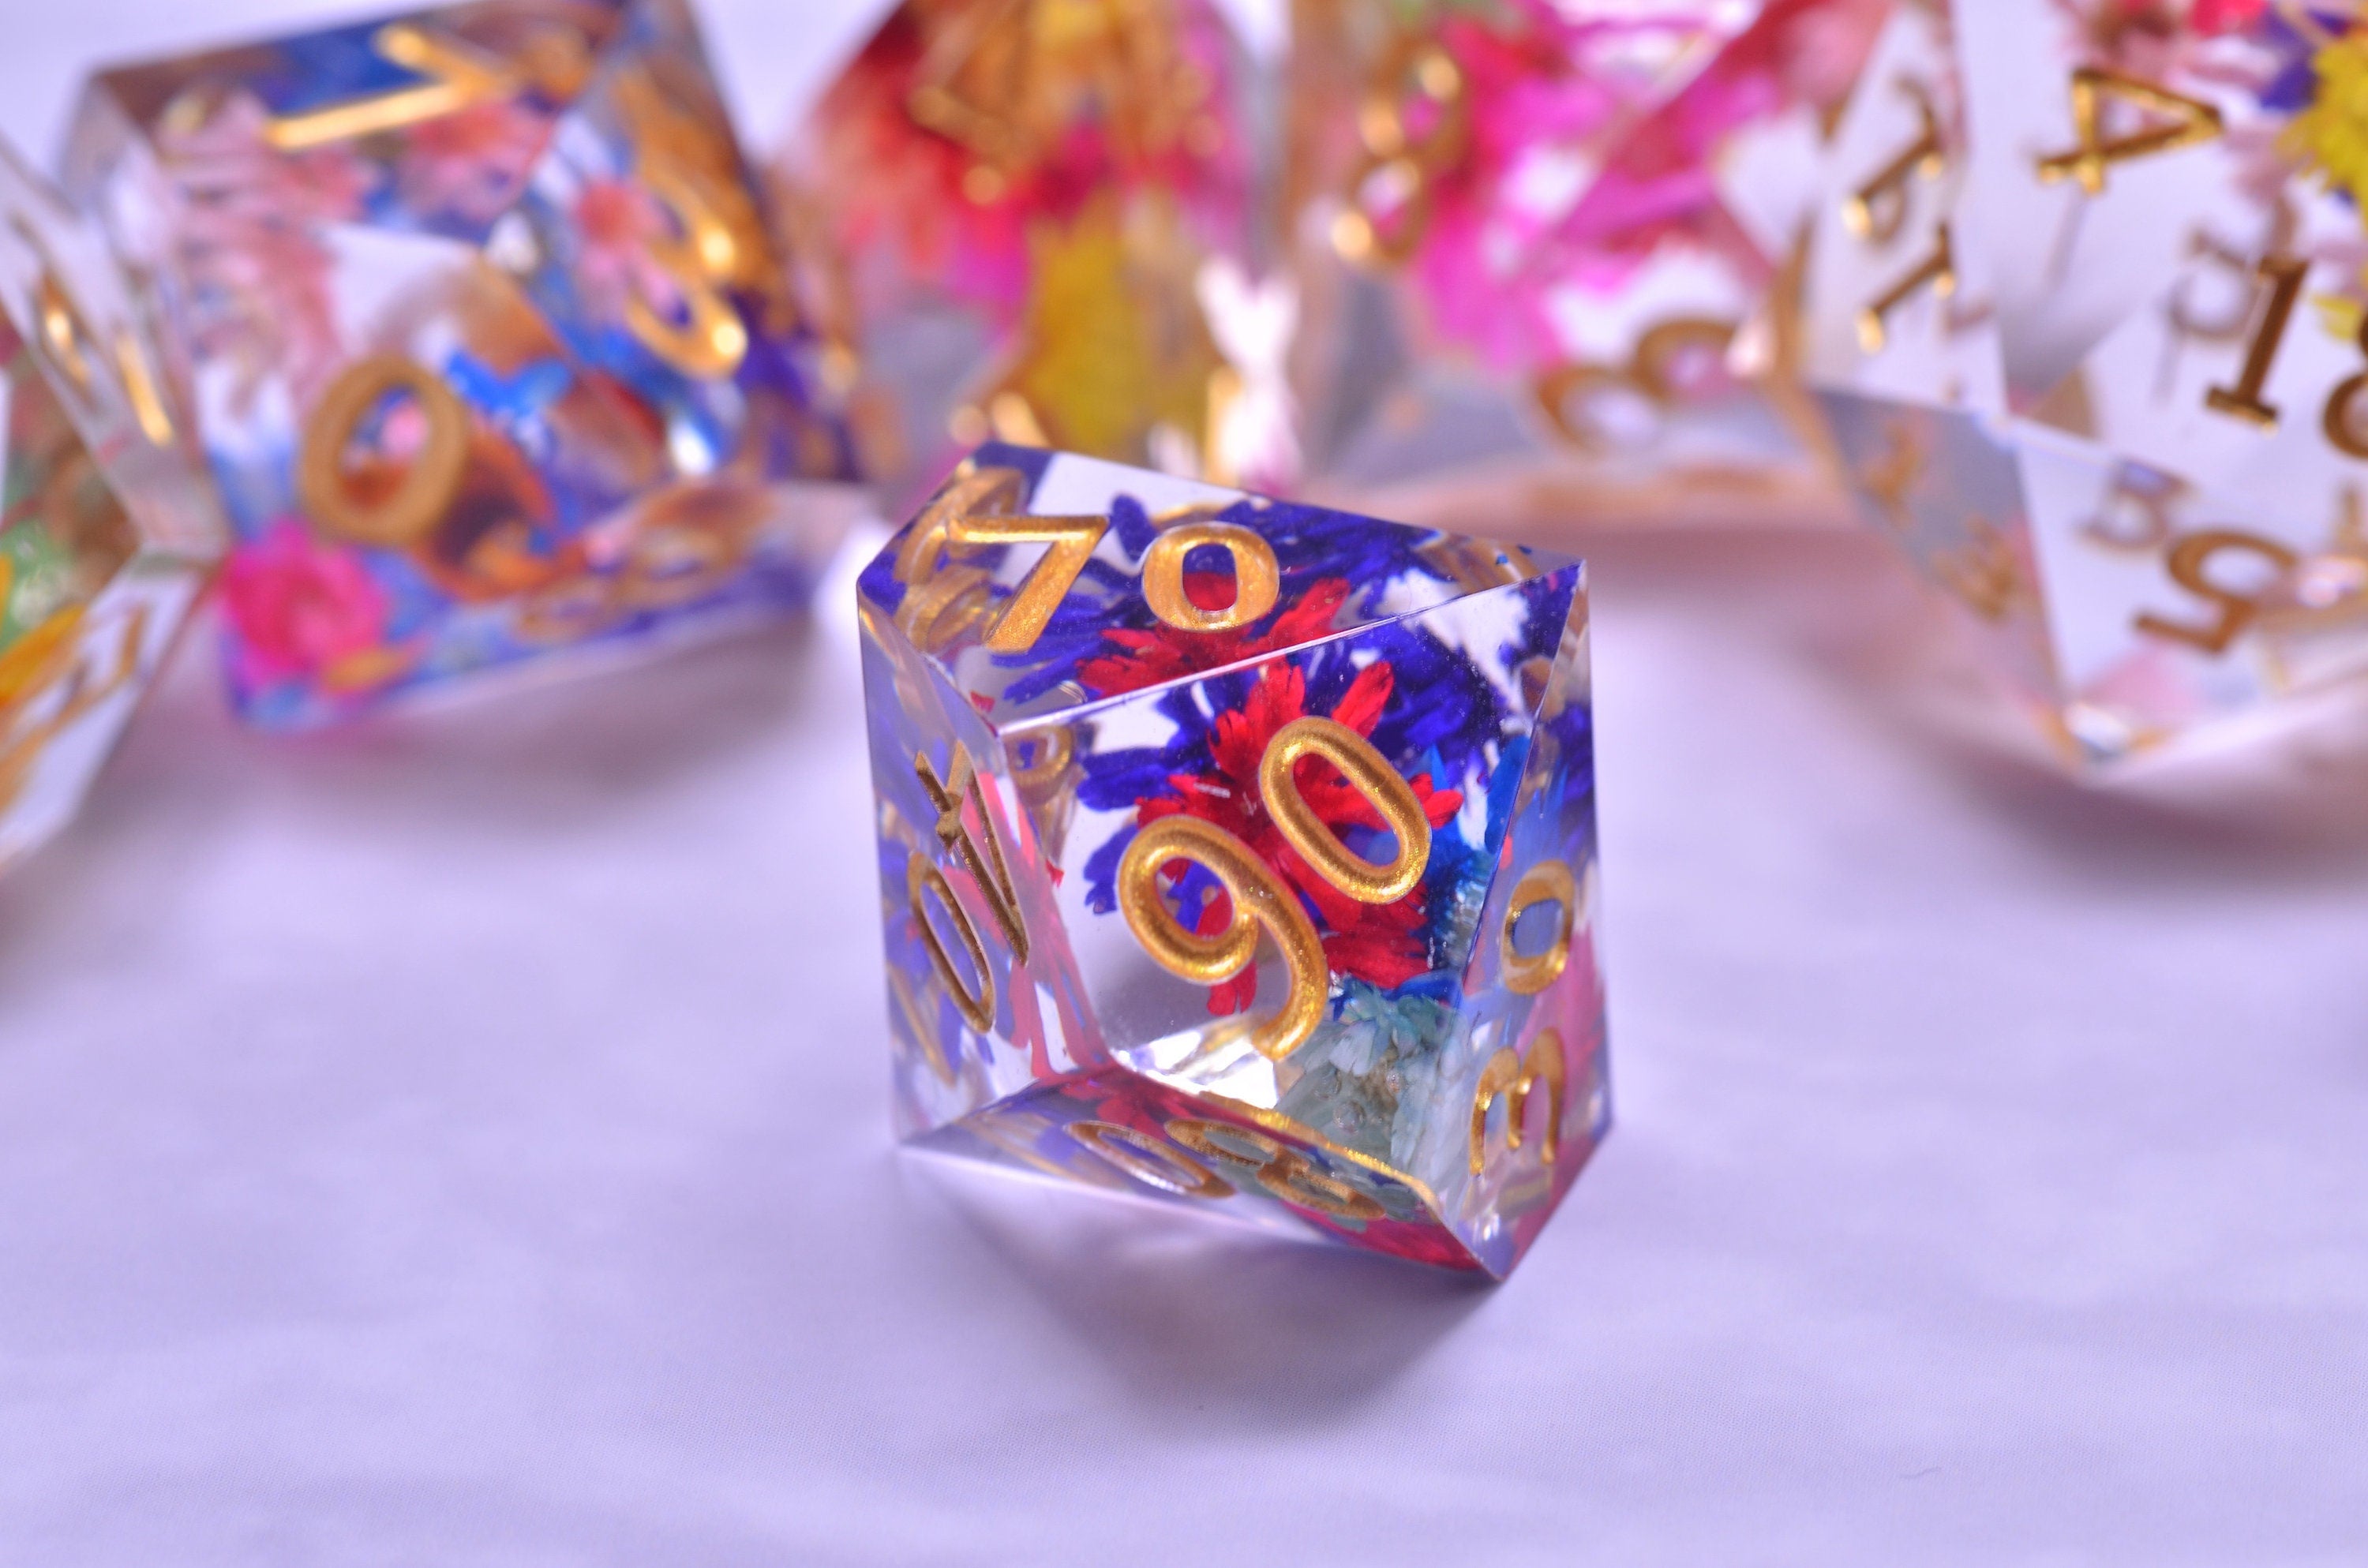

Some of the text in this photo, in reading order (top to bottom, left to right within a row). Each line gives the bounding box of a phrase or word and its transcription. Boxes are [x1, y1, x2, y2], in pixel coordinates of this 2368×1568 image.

[2035, 66, 2224, 197] 4
[948, 515, 1280, 654] 70
[907, 739, 1029, 1034] 40
[1118, 715, 1432, 1062] 90
[1470, 859, 1576, 1176] 30
[1062, 1118, 1388, 1220] 80
